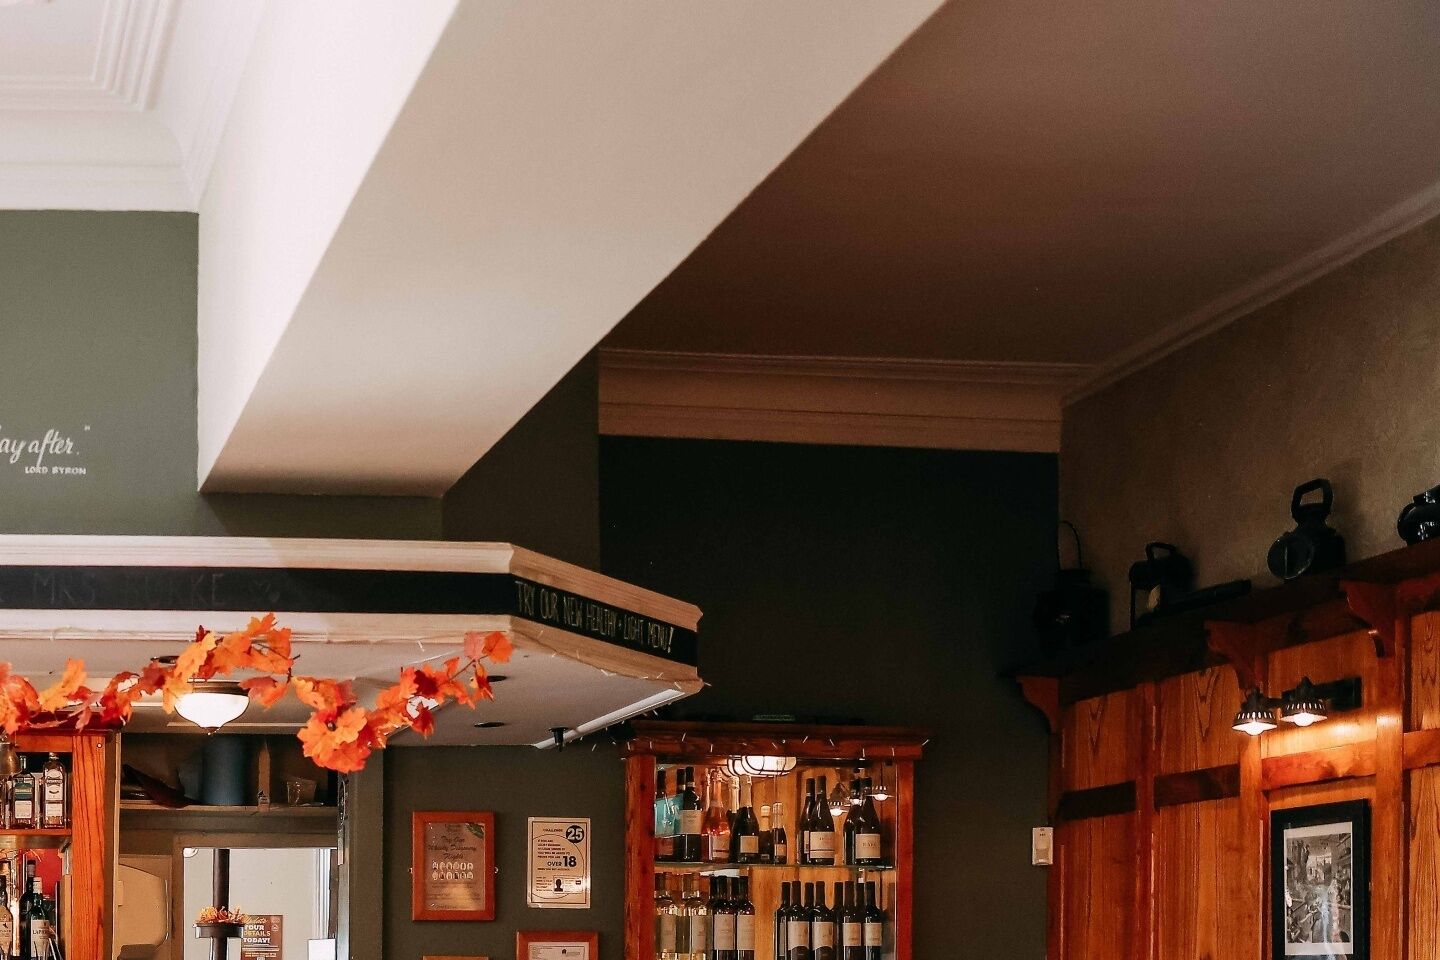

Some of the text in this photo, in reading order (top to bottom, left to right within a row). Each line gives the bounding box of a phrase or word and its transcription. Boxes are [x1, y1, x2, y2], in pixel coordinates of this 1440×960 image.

[24, 466, 87, 476] LORD BYRON
[515, 580, 537, 617] TRY
[540, 588, 560, 622] OUR
[563, 596, 583, 628] NEW
[567, 827, 583, 840] 25
[563, 855, 577, 868] 18
